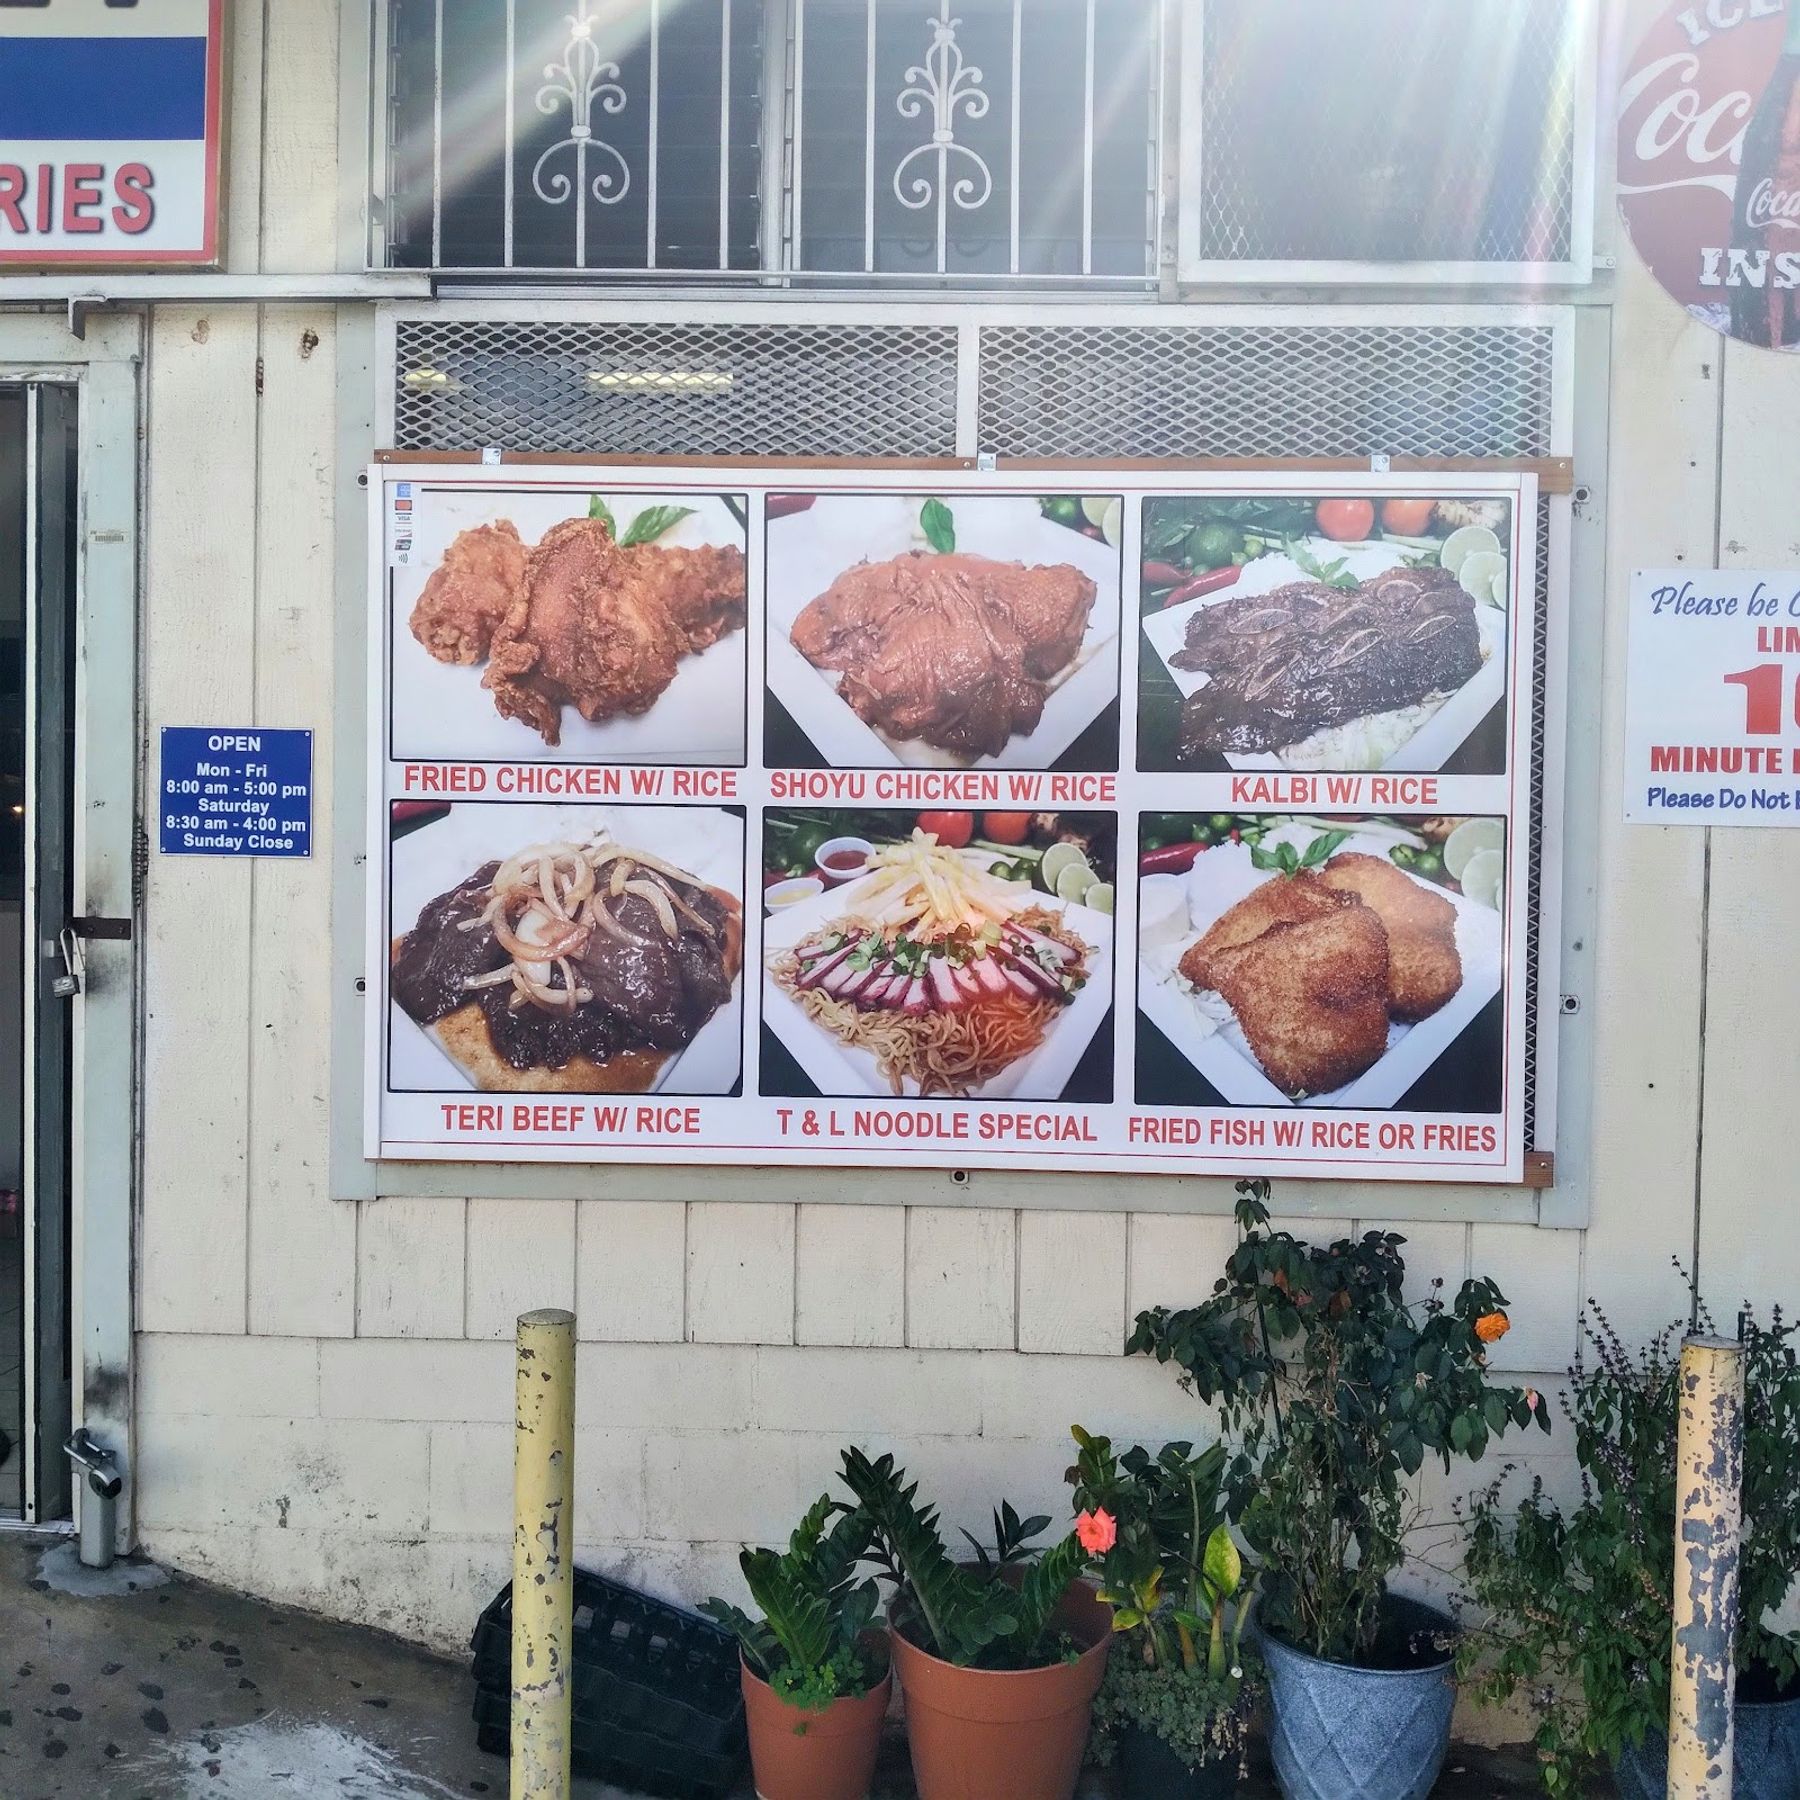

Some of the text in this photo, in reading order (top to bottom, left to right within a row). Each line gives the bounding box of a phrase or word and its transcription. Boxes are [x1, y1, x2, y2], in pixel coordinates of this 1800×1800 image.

[1617, 52, 1751, 165] Coc
[1699, 247, 1800, 289] INS
[1651, 581, 1737, 616] Please
[1747, 582, 1779, 617] be
[1724, 664, 1800, 734] 1
[208, 736, 261, 752] OPEN
[197, 763, 229, 777] Mon
[246, 764, 266, 777] Fri
[1651, 746, 1782, 773] MINUTE
[167, 780, 199, 794] 8:00
[204, 783, 227, 794] am
[244, 782, 276, 795] 5:00
[282, 785, 306, 798] pm
[404, 765, 736, 796] FRIED CHICKEN W/ RICE
[770, 771, 1115, 801] SHOYU CHICKEN W/ RICE
[1232, 777, 1438, 805] KALBI W/ RICE
[198, 798, 269, 816] Saturday
[1648, 787, 1714, 808] Please
[1720, 789, 1745, 809] Do
[1751, 789, 1790, 809] Not
[166, 816, 199, 829] 8:30
[204, 818, 227, 830] am
[243, 817, 276, 831] 4:00
[282, 821, 305, 834] pm
[184, 834, 293, 850] Sunday Close
[441, 1105, 700, 1133] TERI BEEF W/ RICE
[777, 1110, 1097, 1141] T & L NOODLE SPECIAL
[1129, 1117, 1496, 1152] FRIED FISH W/ RICE OR FRIES
